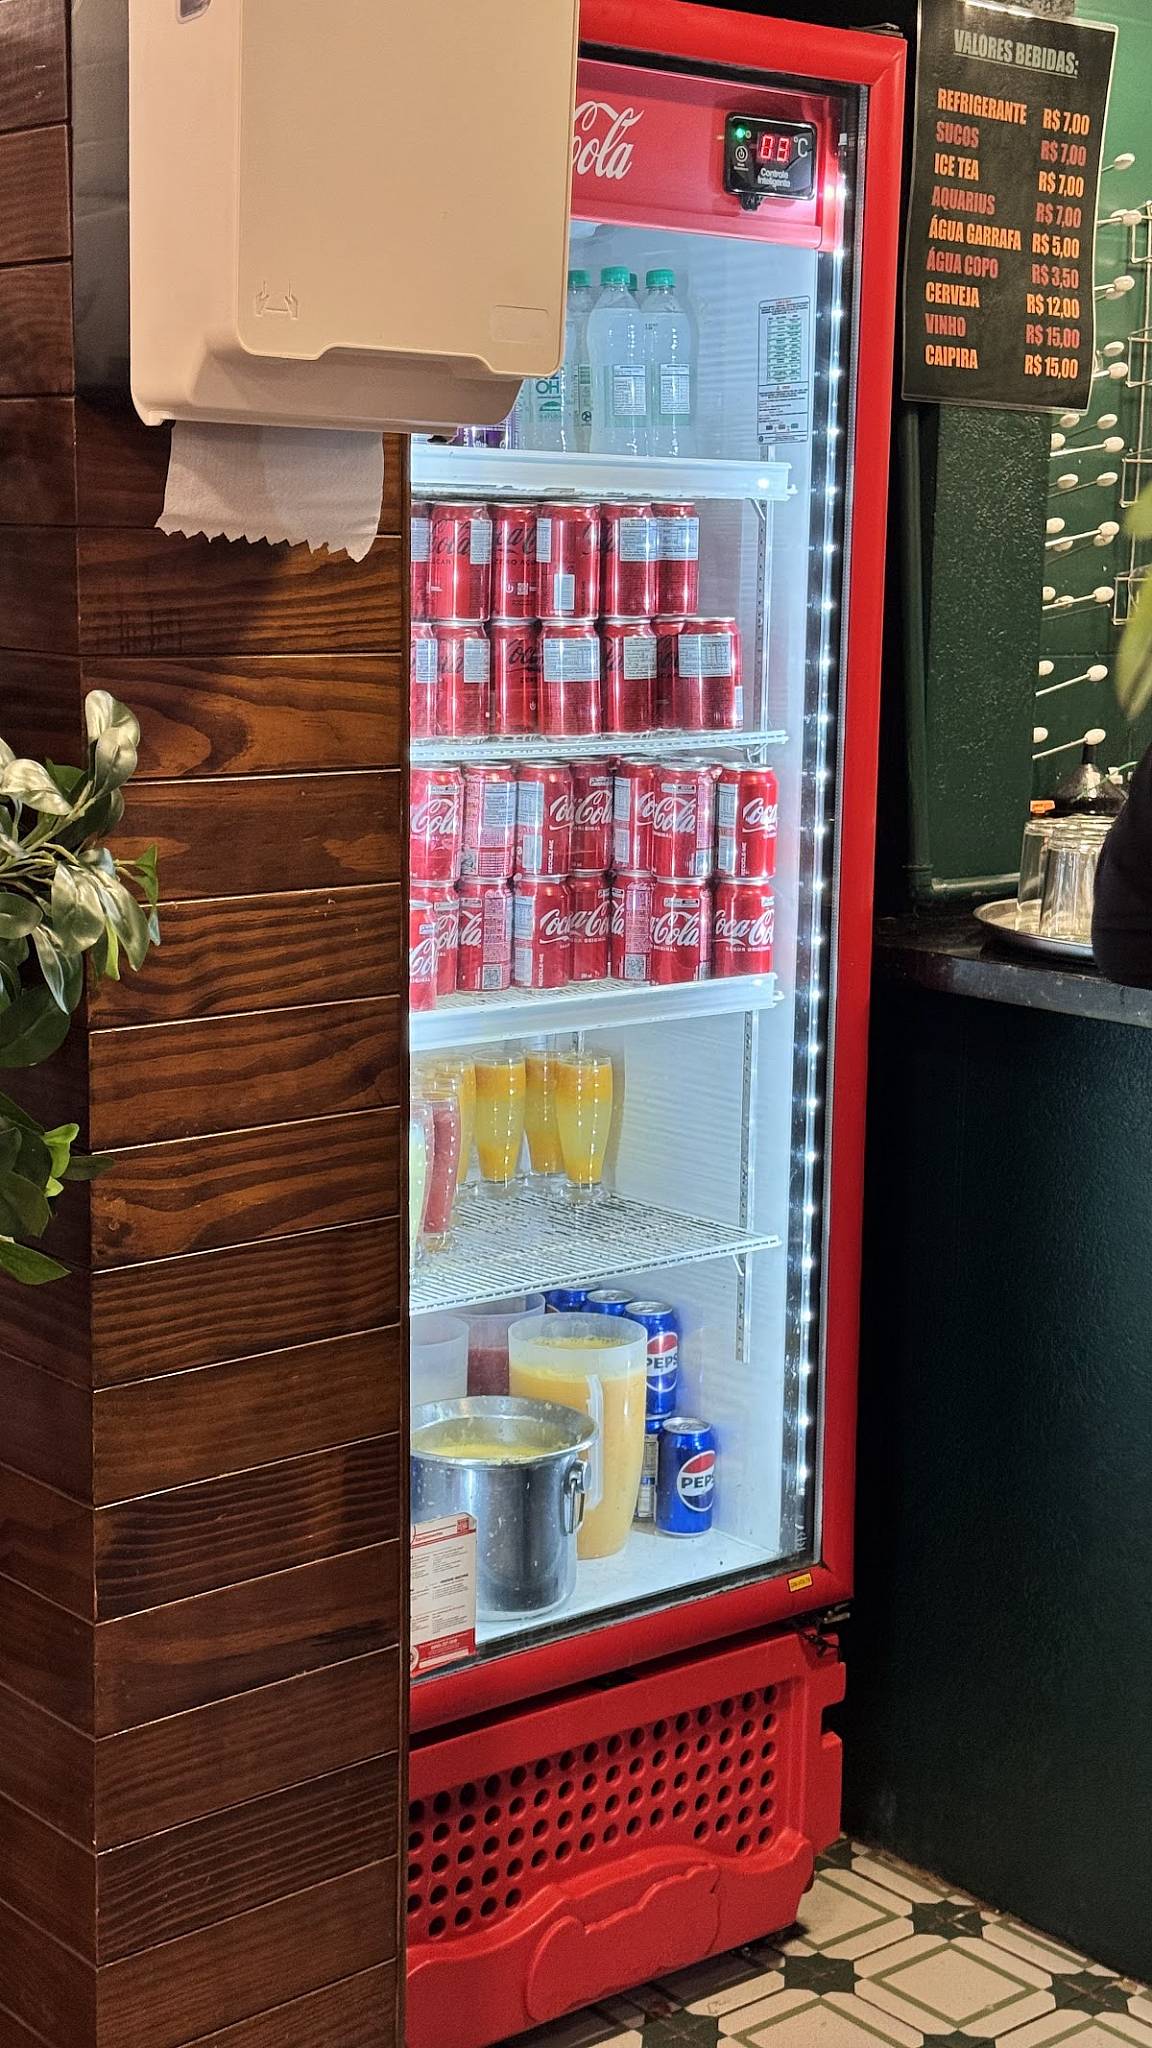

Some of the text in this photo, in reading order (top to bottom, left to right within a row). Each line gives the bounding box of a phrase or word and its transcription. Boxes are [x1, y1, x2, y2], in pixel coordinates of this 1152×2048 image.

[954, 29, 1080, 76] VALORES BEBIDAS:
[937, 88, 1091, 137] REFRIGERANTE R$ 7,00
[936, 121, 1087, 168] SUCOS R$ 7,00
[934, 153, 1085, 199] ICE TEA R$ 7,00
[931, 185, 1082, 229] AQUARIUS R$ 7,00
[928, 213, 1080, 260] ÁGUA GARRAFA R$ 5,00
[926, 246, 1080, 290] ÁGUA COPO R$ 3,50
[925, 281, 1081, 320] CERVEJA R$ 12,00
[925, 313, 1081, 350] VINHO R$ 15,00
[925, 344, 1079, 380] CAIPIRA R$ 15,00
